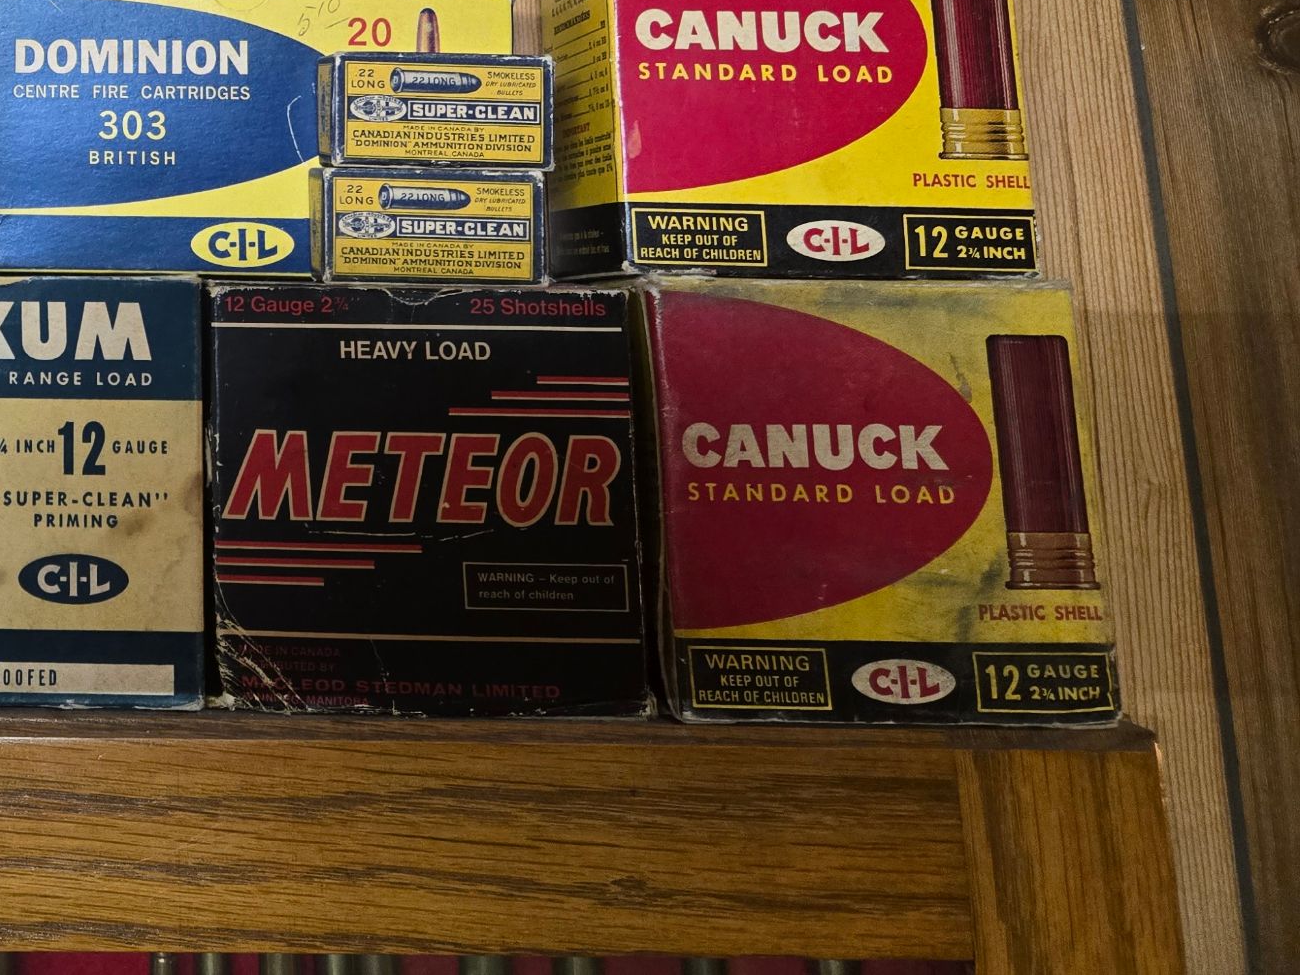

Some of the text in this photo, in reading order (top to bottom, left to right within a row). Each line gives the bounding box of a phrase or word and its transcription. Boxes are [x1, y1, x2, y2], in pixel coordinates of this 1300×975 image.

[348, 18, 391, 47] 20
[635, 9, 889, 53] CANUCK
[15, 39, 249, 75] DOMINION
[488, 72, 535, 80] SMOKELESS
[638, 63, 893, 83] STANDARD LOAD
[352, 80, 385, 88] LONG
[13, 85, 250, 100] CENTRE FIRE CARTRIDGES
[412, 104, 535, 120] SUPER-CLEAN
[99, 111, 166, 140] 303
[353, 130, 535, 143] CANADIAN INDUSTRIES LIMITED
[413, 141, 531, 152] AMMUNITION DIVISION
[89, 151, 176, 165] BRITISH
[913, 173, 1030, 190] PLASTIC SHELL
[402, 220, 524, 237] SUPER-CLEAN
[648, 216, 749, 232] WARNING
[662, 234, 737, 247] KEEP OUT OF
[955, 226, 1024, 240] GAUGE
[915, 226, 948, 258] 12
[641, 248, 761, 260] REACH OF CHILDREN
[983, 247, 1025, 260] INCH
[225, 297, 314, 316] 12 Gauge
[470, 298, 606, 317] 25 Shotshells
[340, 341, 490, 361] HEAVY LOAD
[10, 372, 82, 386] RANGE
[96, 372, 153, 386] LOAD
[16, 421, 168, 476] INCH 12 GAUGE
[682, 422, 949, 471] CANUCK
[222, 429, 622, 527] METEOR
[688, 483, 955, 505] STANDARD LOAD
[34, 514, 118, 528] PRIMING
[478, 573, 534, 583] WARNING
[529, 590, 573, 600] children
[356, 681, 561, 698] STEDMAN LIMITED
